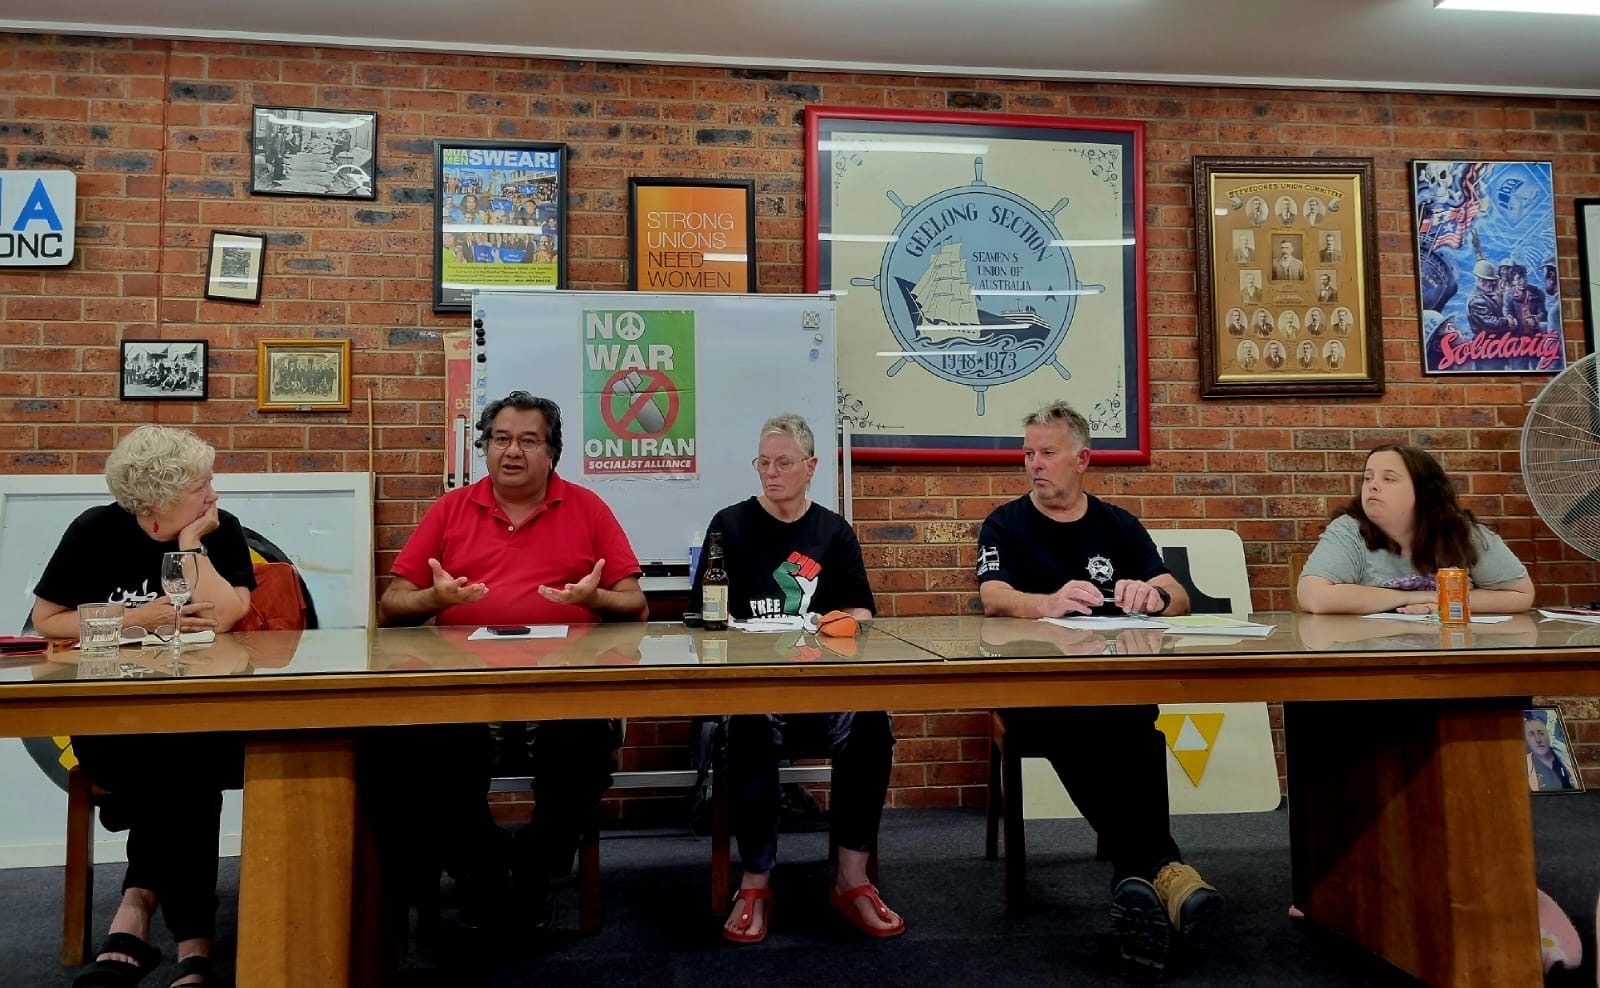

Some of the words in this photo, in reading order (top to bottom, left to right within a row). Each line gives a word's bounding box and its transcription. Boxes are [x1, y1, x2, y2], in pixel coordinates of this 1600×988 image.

[469, 150, 556, 168] SWEAR!
[0, 178, 63, 231] A
[647, 211, 734, 230] STRONG
[647, 231, 727, 249] UNIONS
[905, 202, 978, 258] GEELONG
[989, 205, 1053, 263] SECTION
[648, 251, 704, 268] NEED
[647, 270, 731, 288] WOMEN
[978, 266, 1007, 276] UNION
[1011, 267, 1024, 277] OF
[978, 280, 1032, 291] AUSTRALIA
[586, 344, 675, 371] WAR
[1437, 330, 1561, 370] Solidarity
[985, 351, 1017, 370] 1973
[584, 438, 623, 458] ON
[631, 438, 695, 457] IRAN
[644, 460, 691, 468] ALLIANCE
[750, 598, 781, 617] FREE
